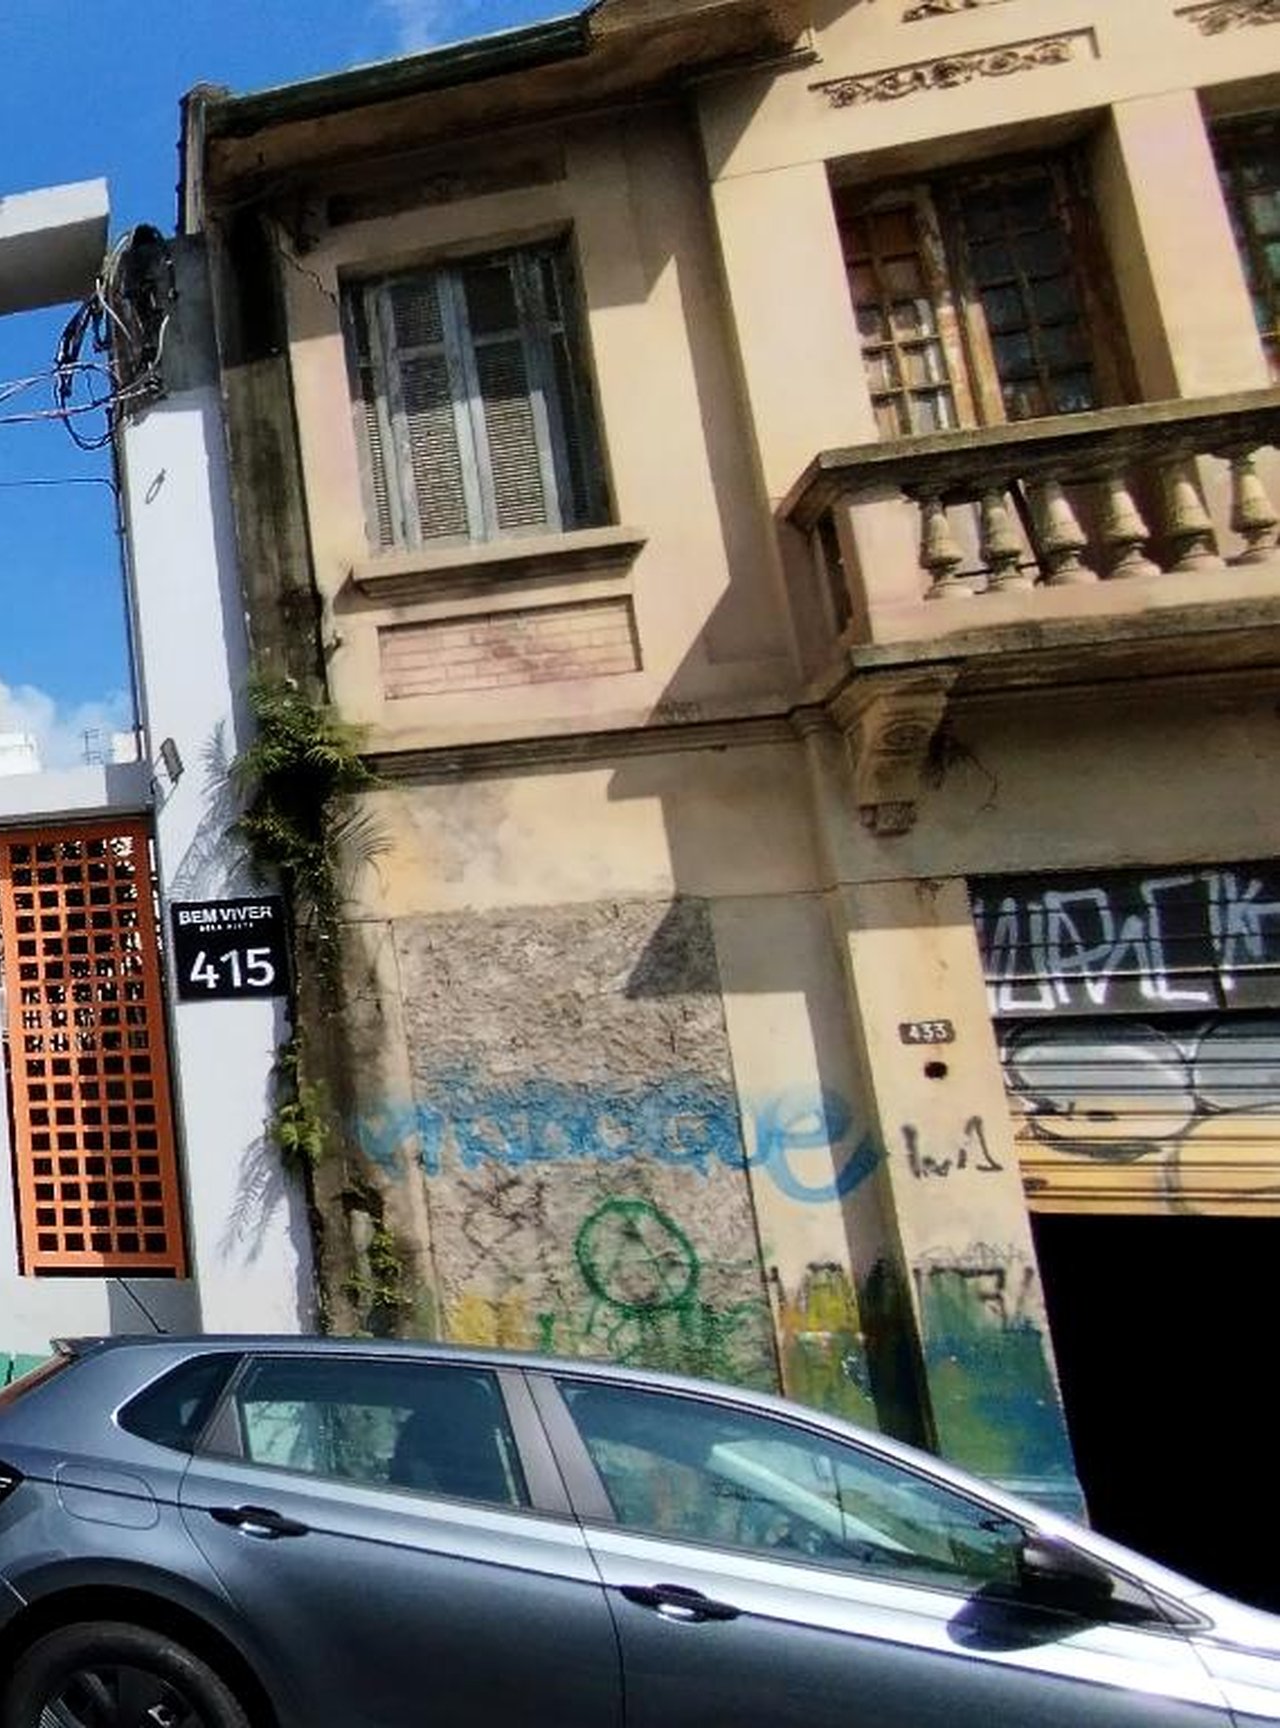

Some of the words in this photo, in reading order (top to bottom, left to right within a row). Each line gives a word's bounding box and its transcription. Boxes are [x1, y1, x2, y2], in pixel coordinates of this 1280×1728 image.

[179, 909, 216, 925] BEM
[219, 906, 272, 920] VIVER
[190, 947, 276, 989] 415
